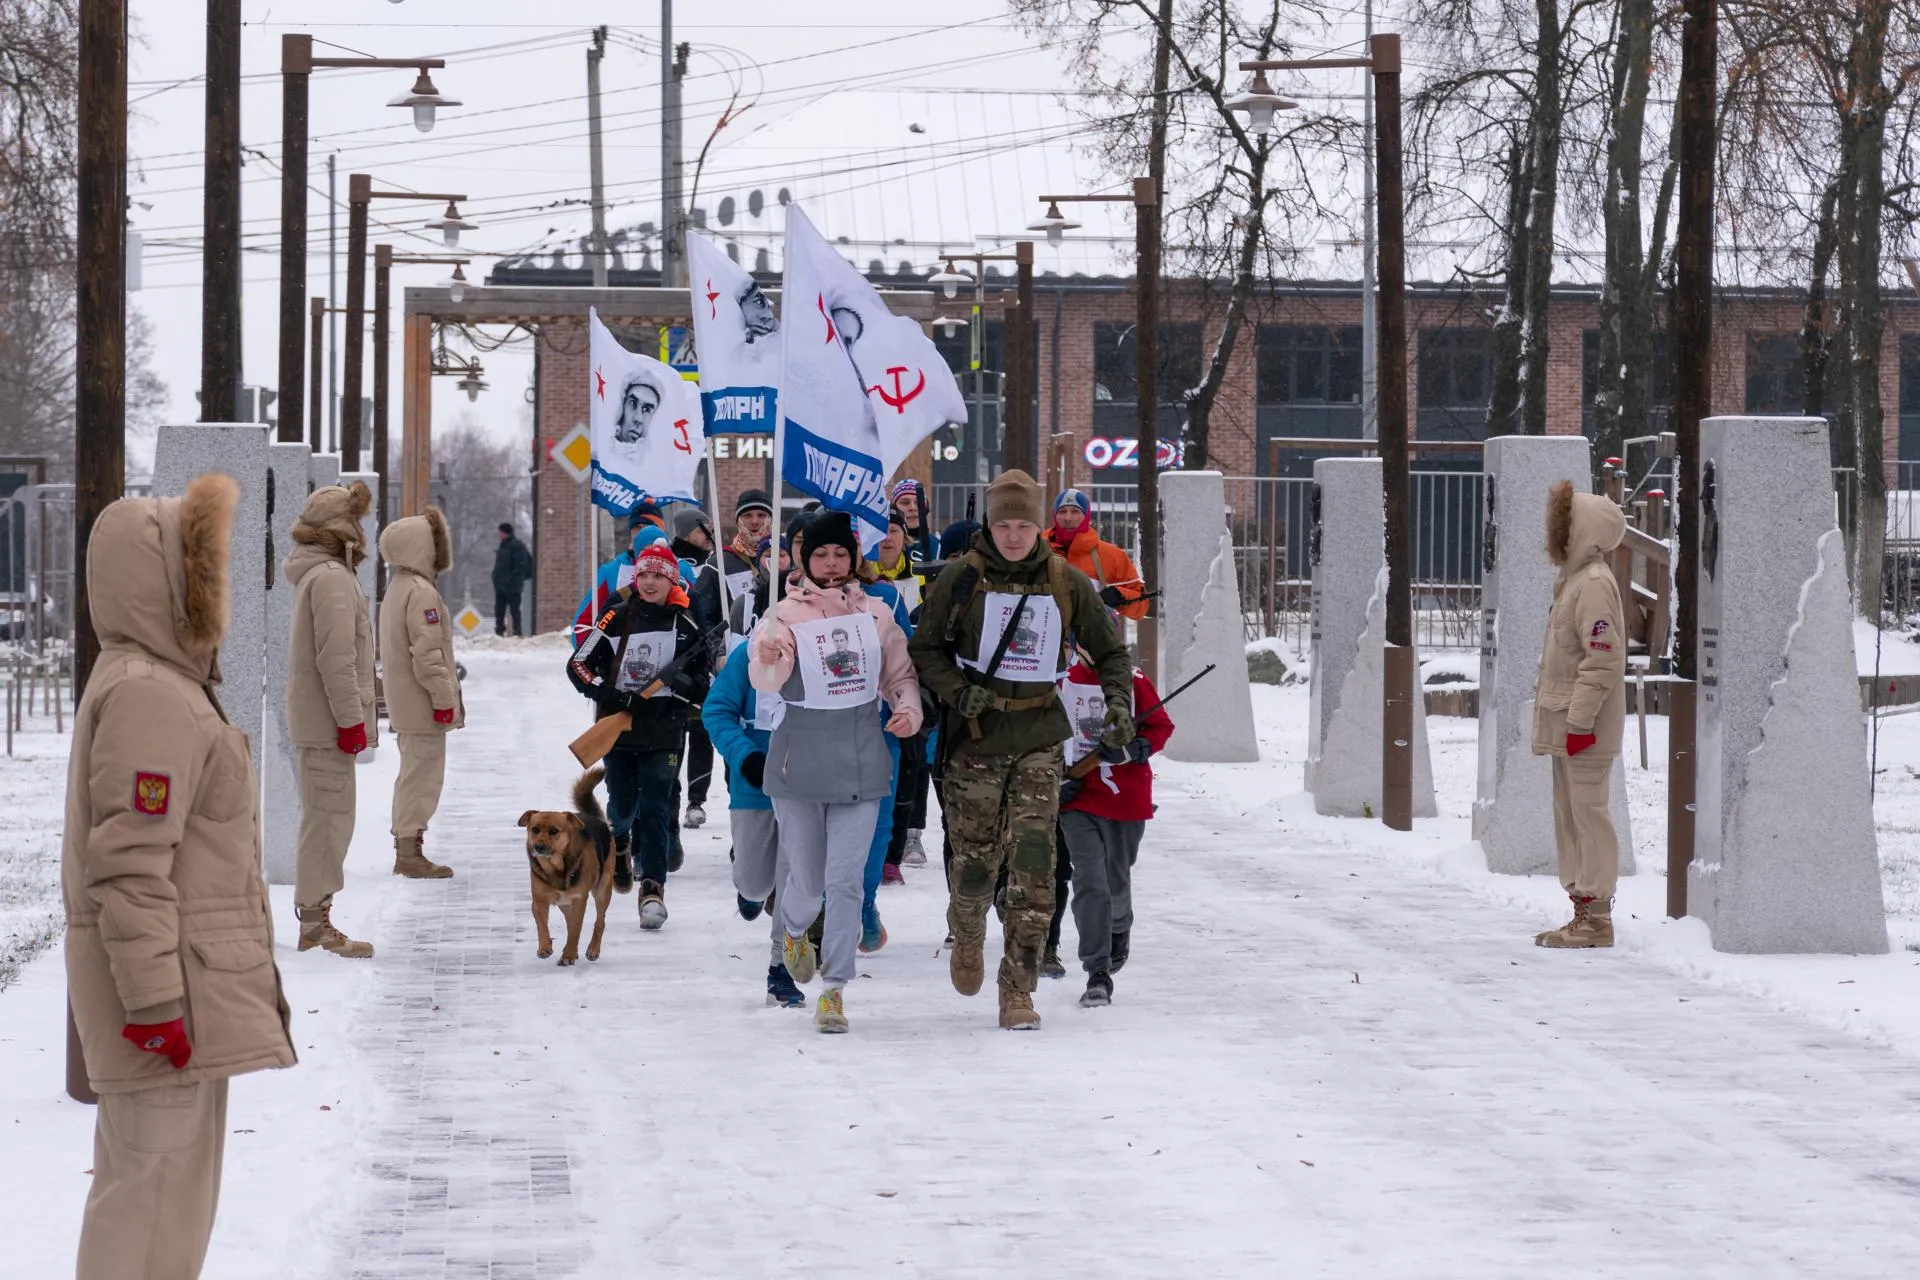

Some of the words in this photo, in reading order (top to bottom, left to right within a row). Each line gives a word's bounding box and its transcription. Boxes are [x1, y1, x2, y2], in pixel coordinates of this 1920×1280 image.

[1002, 606, 1012, 616] 21
[815, 634, 826, 644] 21
[626, 648, 634, 656] 21
[827, 685, 866, 696] ЛЕОНОВ
[1076, 697, 1084, 706] 21
